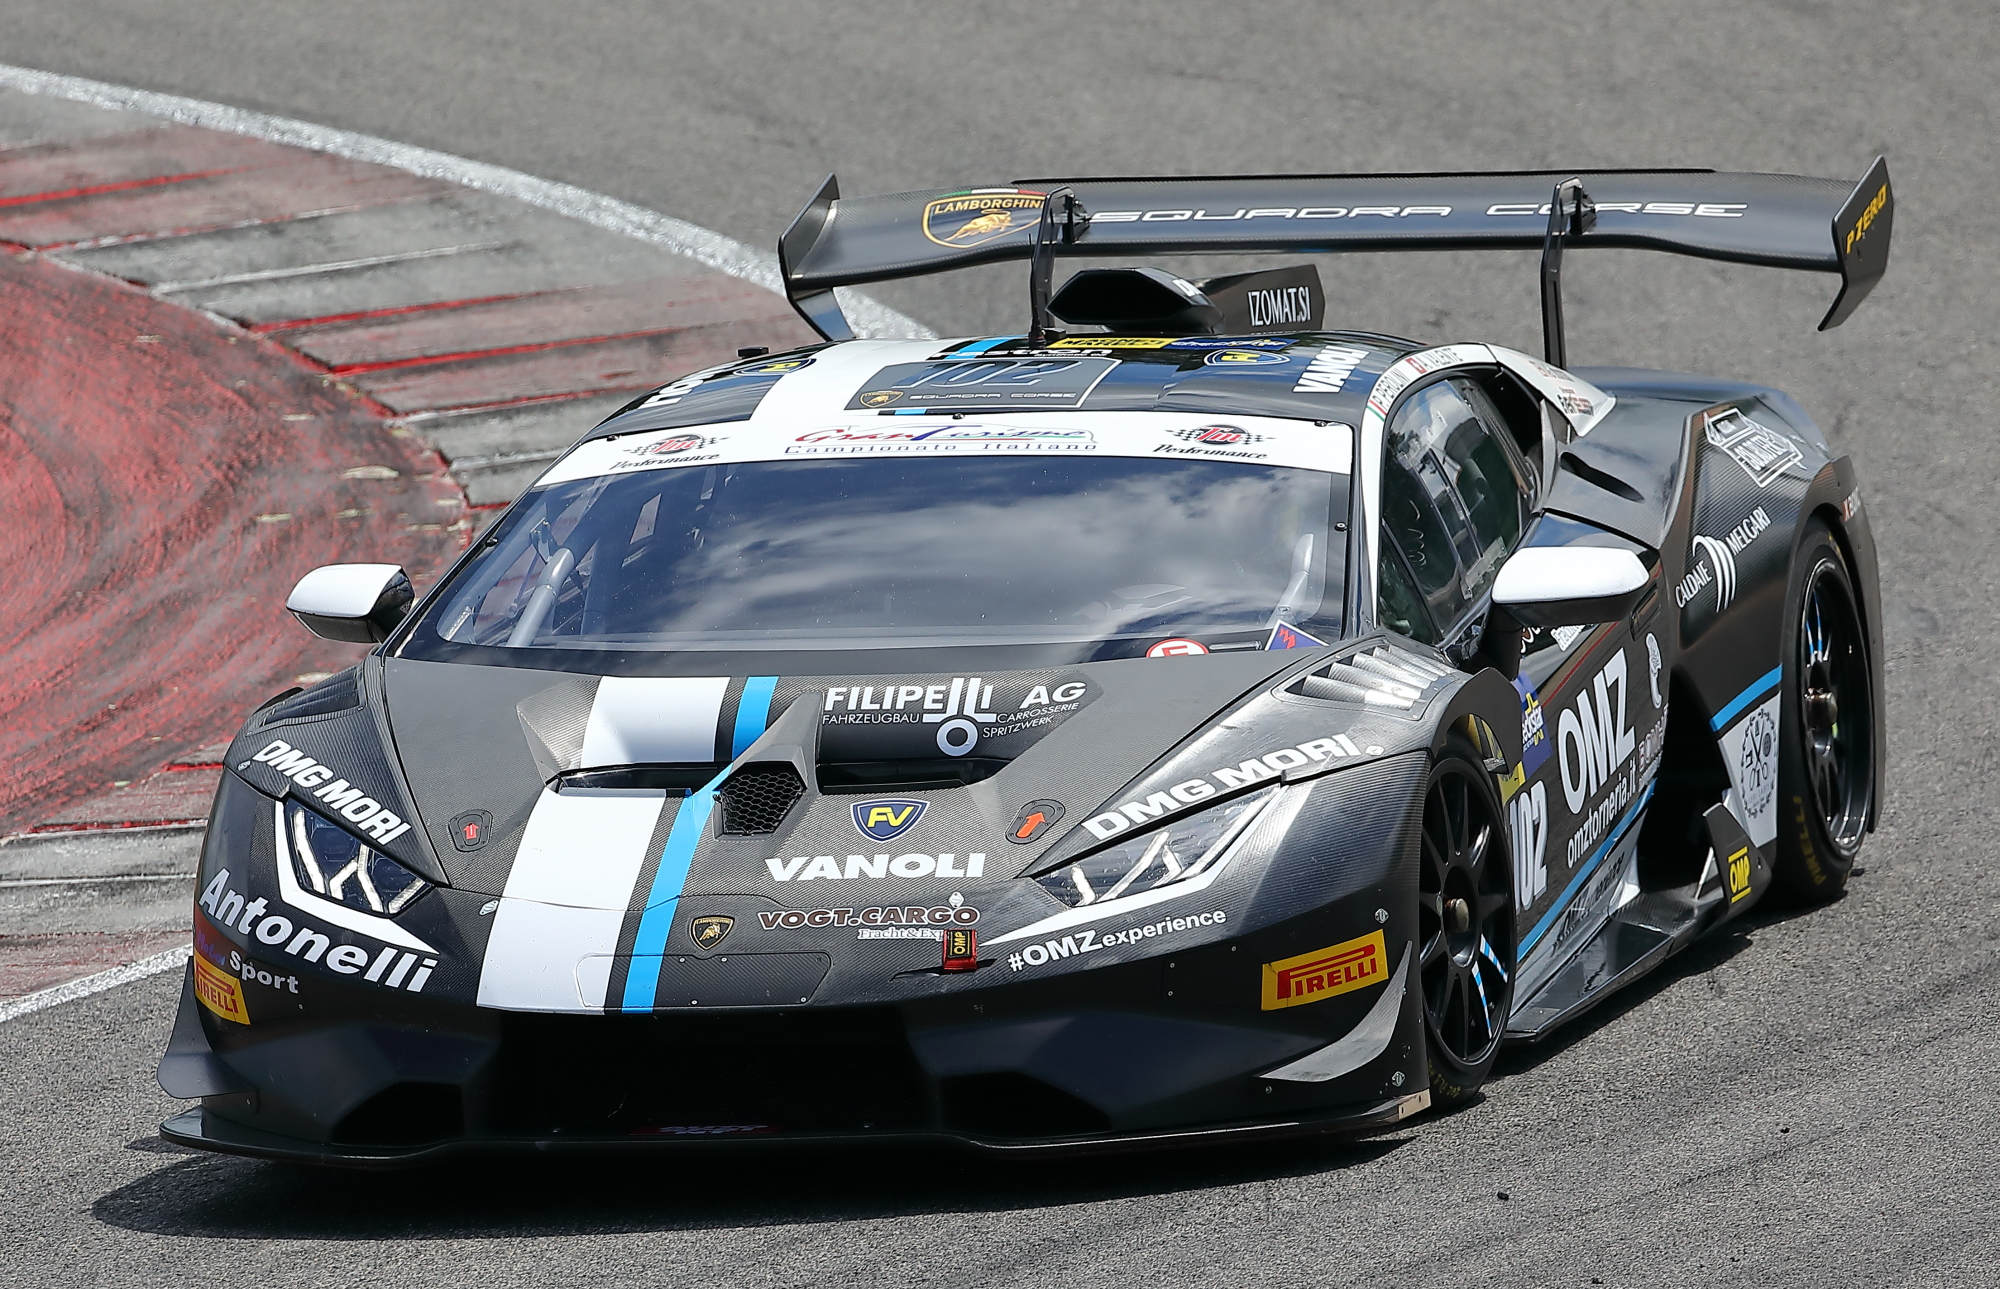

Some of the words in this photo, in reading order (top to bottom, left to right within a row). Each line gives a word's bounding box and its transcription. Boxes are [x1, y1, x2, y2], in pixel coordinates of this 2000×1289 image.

[1091, 206, 1452, 223] SQUADRA
[1486, 203, 1748, 218] CRSE
[1846, 229, 1855, 254] P
[1856, 183, 1887, 241] ZERO
[1248, 286, 1311, 327] IZOMAT.SI
[891, 360, 1083, 389] 102
[1292, 345, 1370, 393] VANOLI
[785, 445, 957, 454] Campionato
[982, 443, 1098, 451] Italiano
[1152, 443, 1268, 459] Performance
[1725, 506, 1771, 556] MELCARI
[1675, 560, 1713, 608] CALDAIE
[822, 713, 921, 725] FAHRZEUGBAU
[997, 702, 1079, 723] CARROSSERIE
[1019, 682, 1087, 709] AG
[983, 715, 1054, 738] SPRITZWERK
[1557, 647, 1635, 815] OMZ
[252, 739, 334, 788] DMG
[312, 778, 412, 846] MORI
[1081, 778, 1215, 841] DMG
[1214, 734, 1362, 788] MORI
[866, 806, 914, 828] FV
[1567, 757, 1636, 869] omztorneria.it
[765, 853, 985, 882] VANOLI
[1510, 780, 1548, 915] 102
[1729, 855, 1751, 894] OMP
[199, 868, 438, 993] Antonelli
[758, 906, 980, 930] VOGT.CARGO
[953, 931, 966, 955] OMP
[196, 960, 240, 1014] PIRELLI
[229, 950, 299, 994] Sport
[1277, 943, 1377, 1000] PIRELLI
